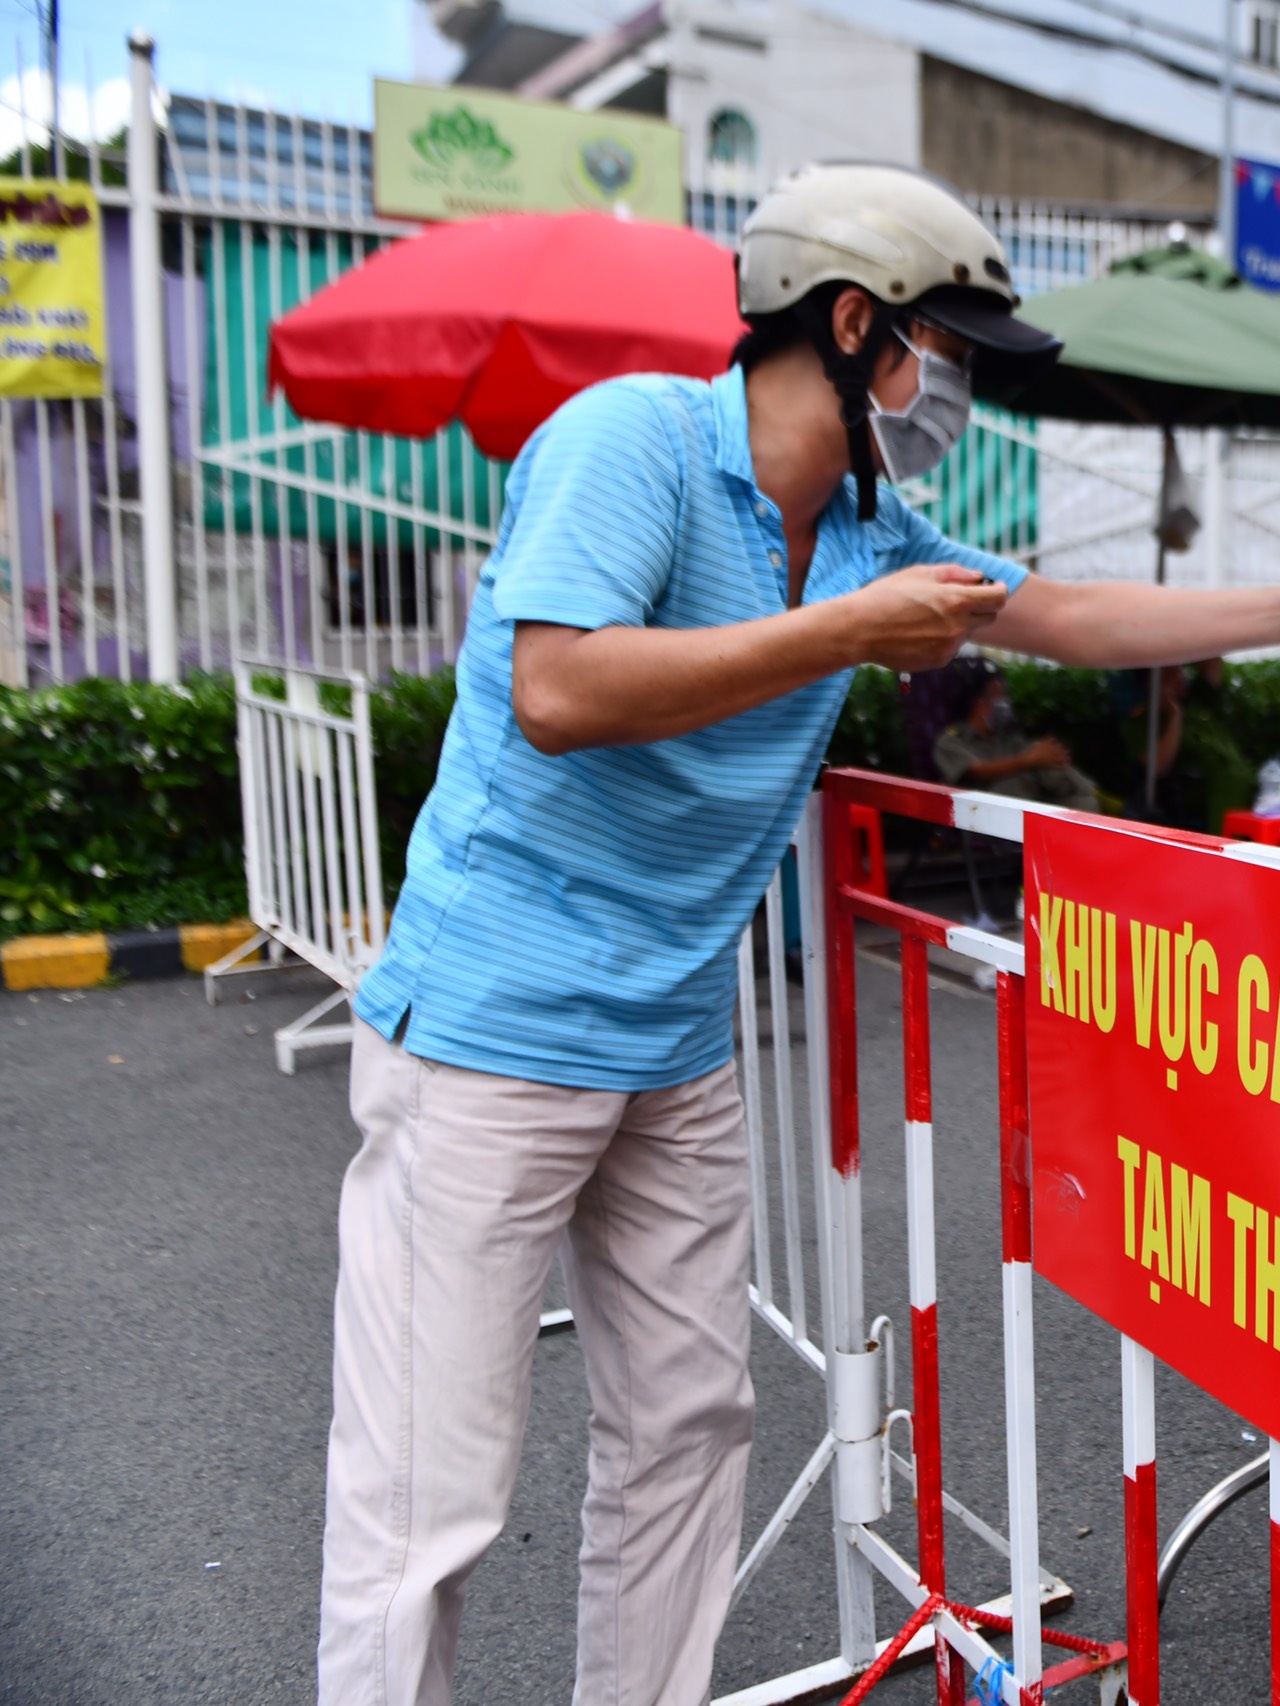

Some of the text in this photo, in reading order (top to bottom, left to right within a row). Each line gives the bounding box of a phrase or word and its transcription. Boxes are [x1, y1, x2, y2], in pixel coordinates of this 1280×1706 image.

[1039, 892, 1117, 1034] KHU
[1130, 921, 1219, 1091] VỰC
[1117, 1134, 1211, 1308] TẠM
